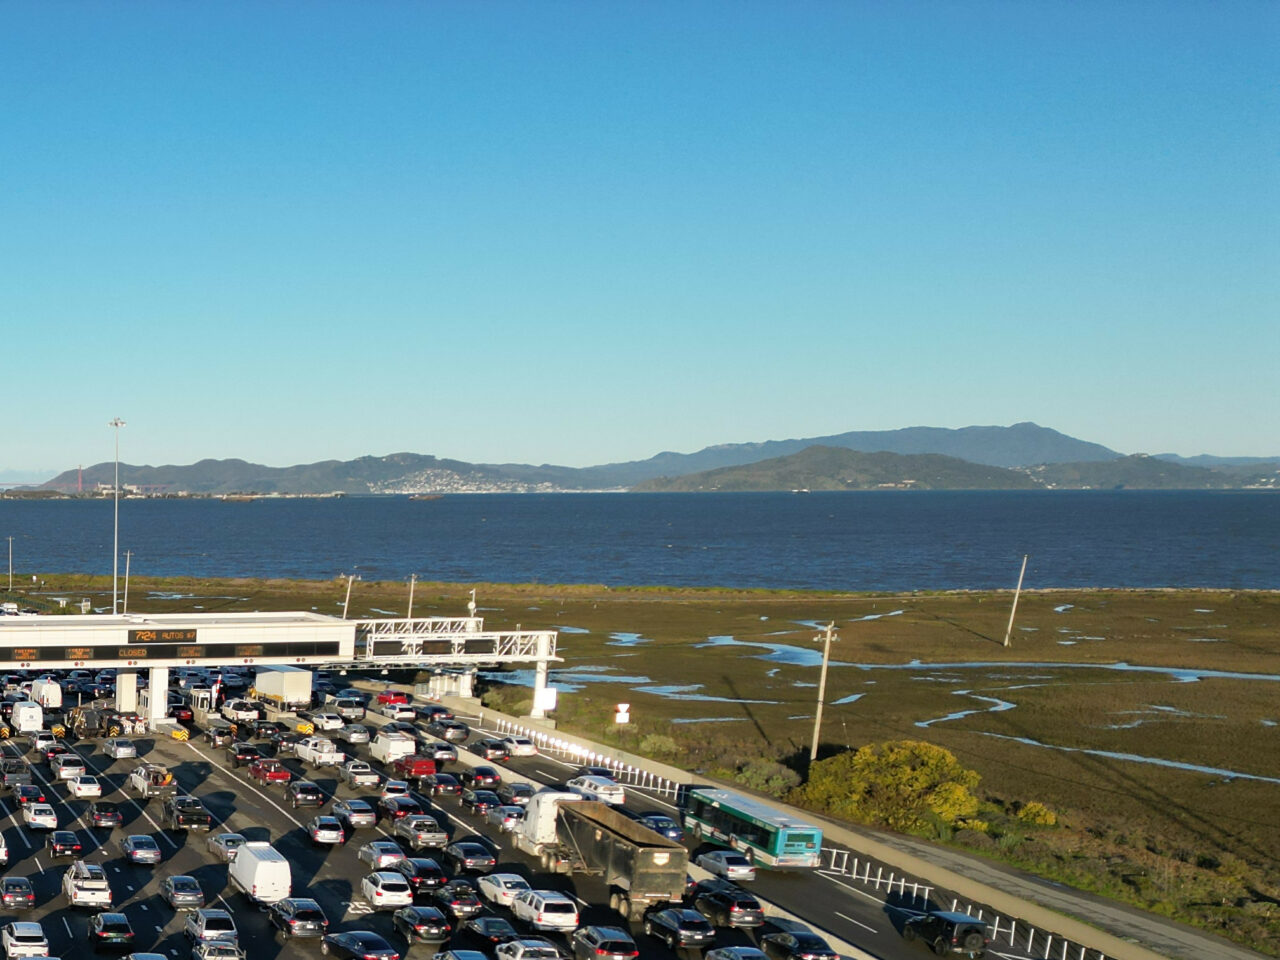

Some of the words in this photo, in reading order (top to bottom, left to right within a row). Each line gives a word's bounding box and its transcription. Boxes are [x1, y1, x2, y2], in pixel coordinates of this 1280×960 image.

[135, 631, 157, 641] 7:24
[161, 631, 185, 640] AUTOS
[118, 648, 147, 657] CLOSED
